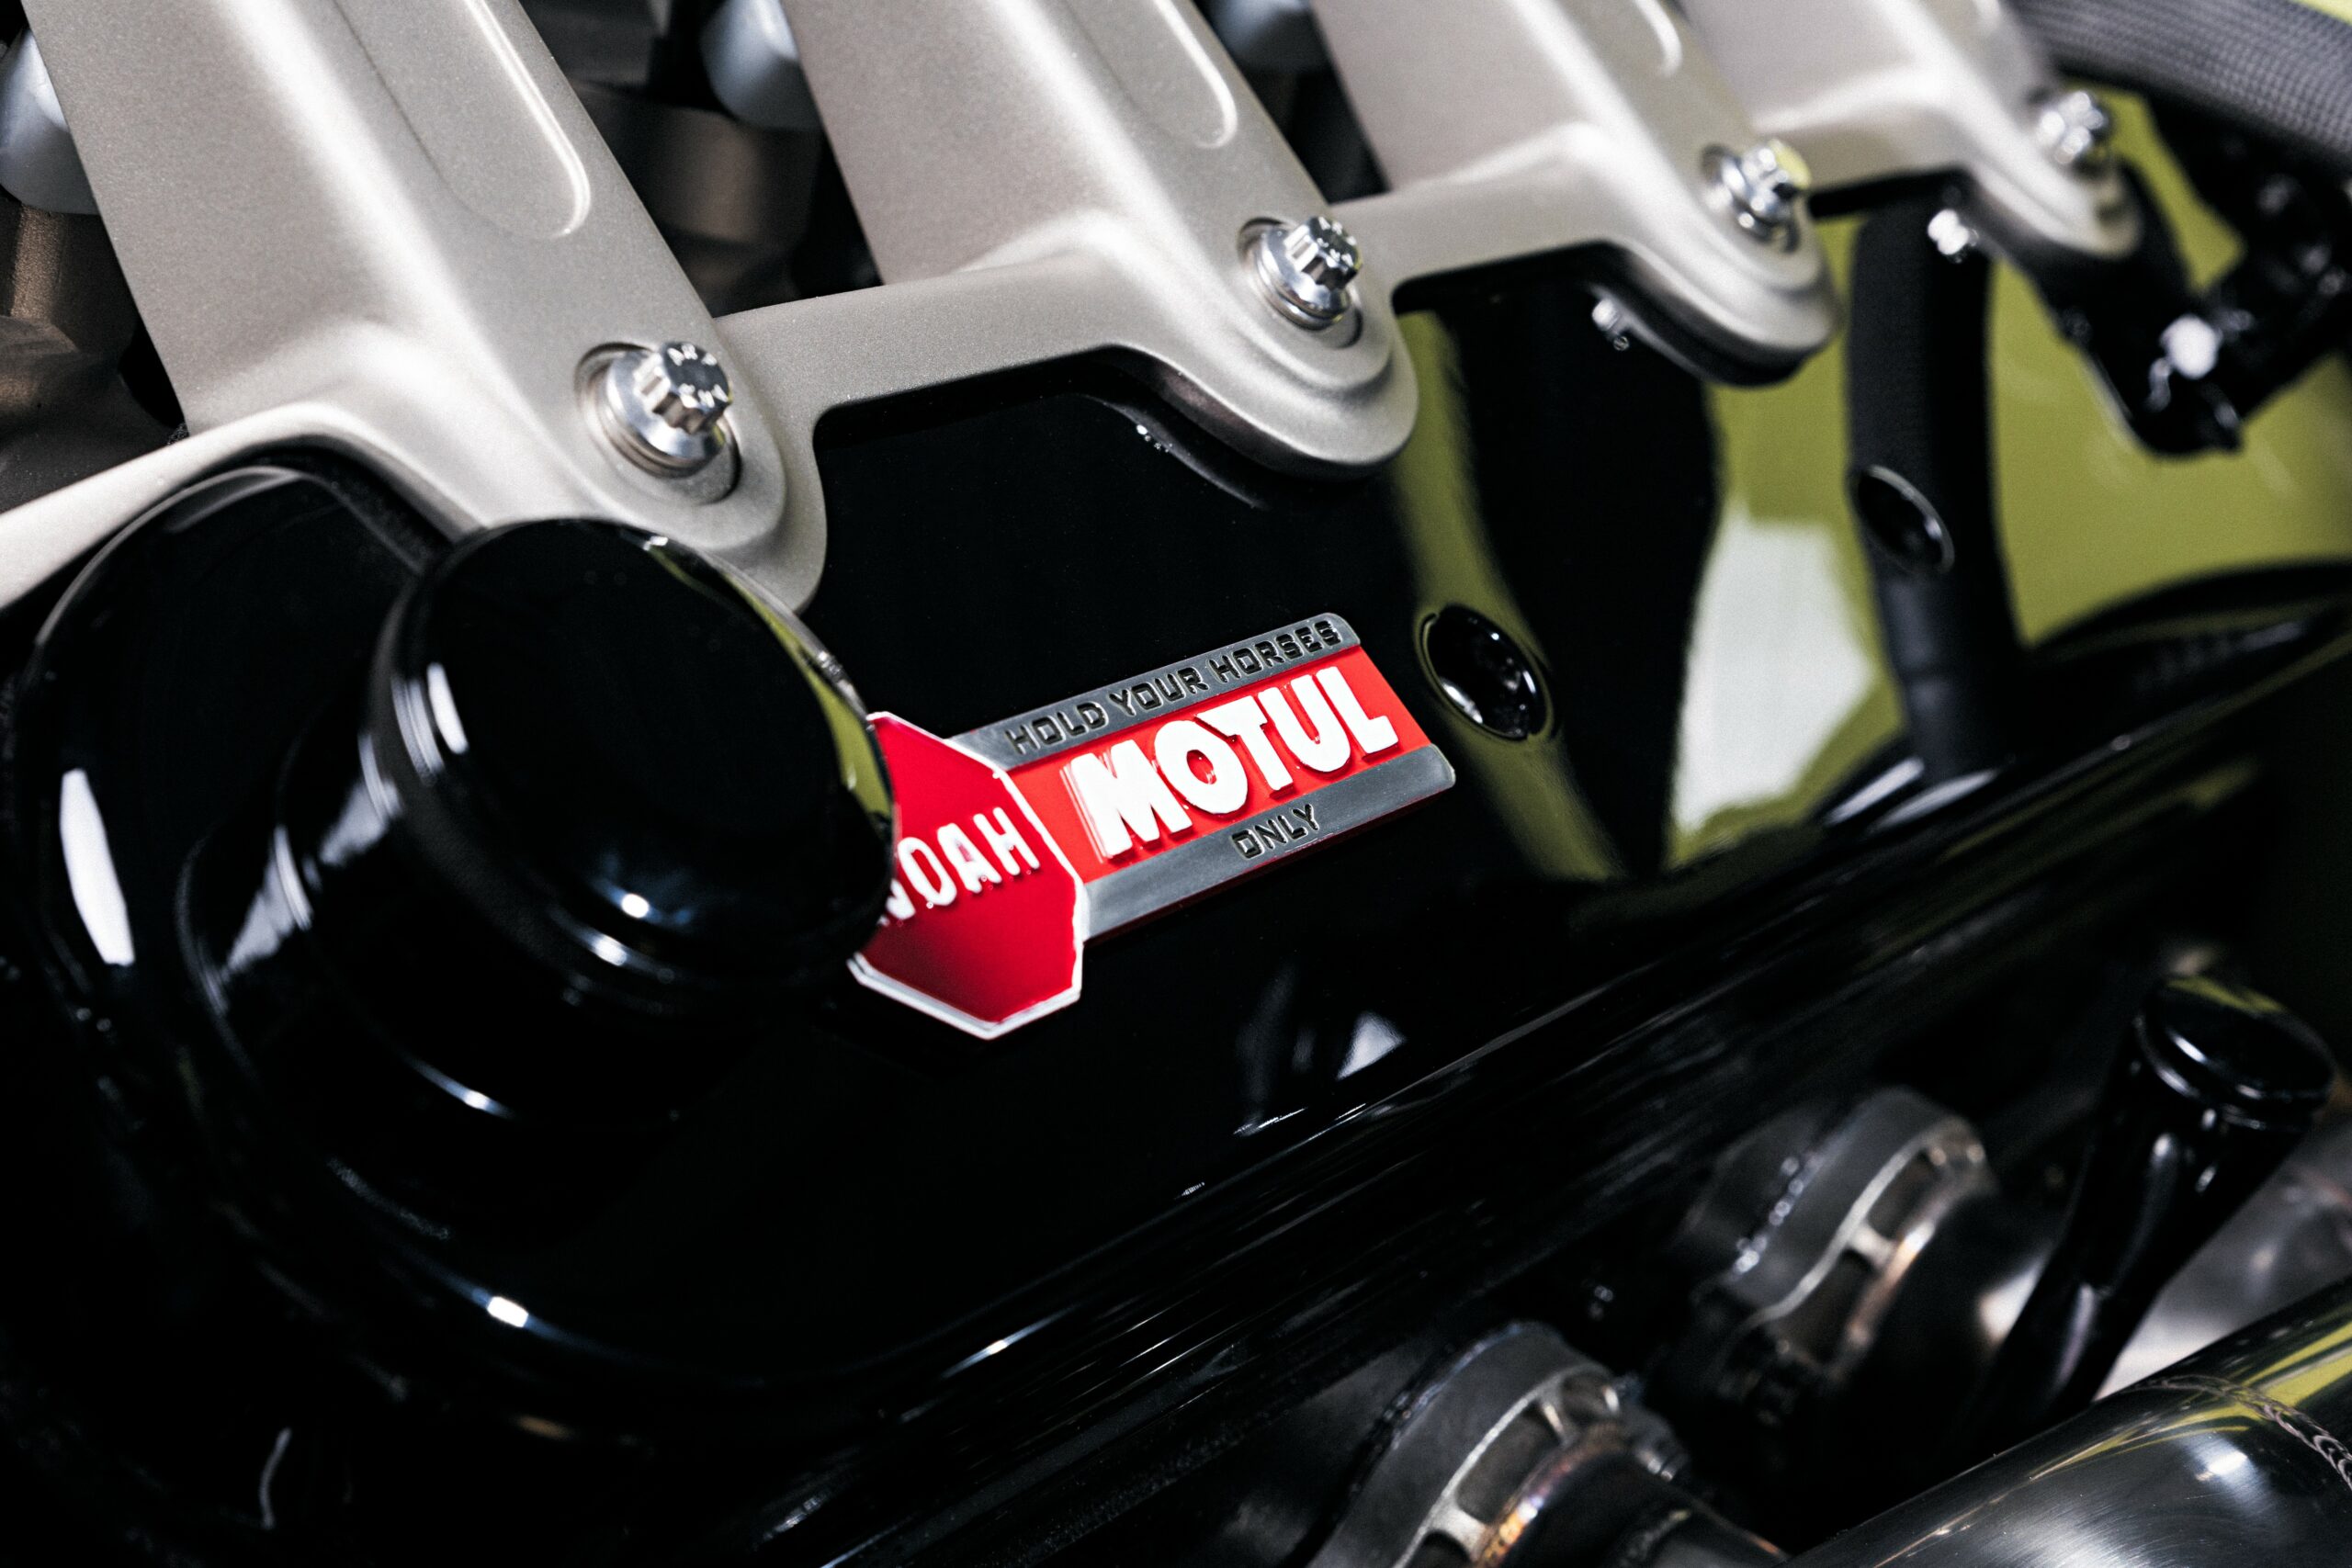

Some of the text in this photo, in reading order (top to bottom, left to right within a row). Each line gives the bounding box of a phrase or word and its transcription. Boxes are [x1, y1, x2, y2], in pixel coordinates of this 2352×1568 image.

[1005, 619, 1342, 755] HOLD YOUR HORSES
[1066, 666, 1399, 859] MOTUL
[1231, 804, 1320, 859] ONLY
